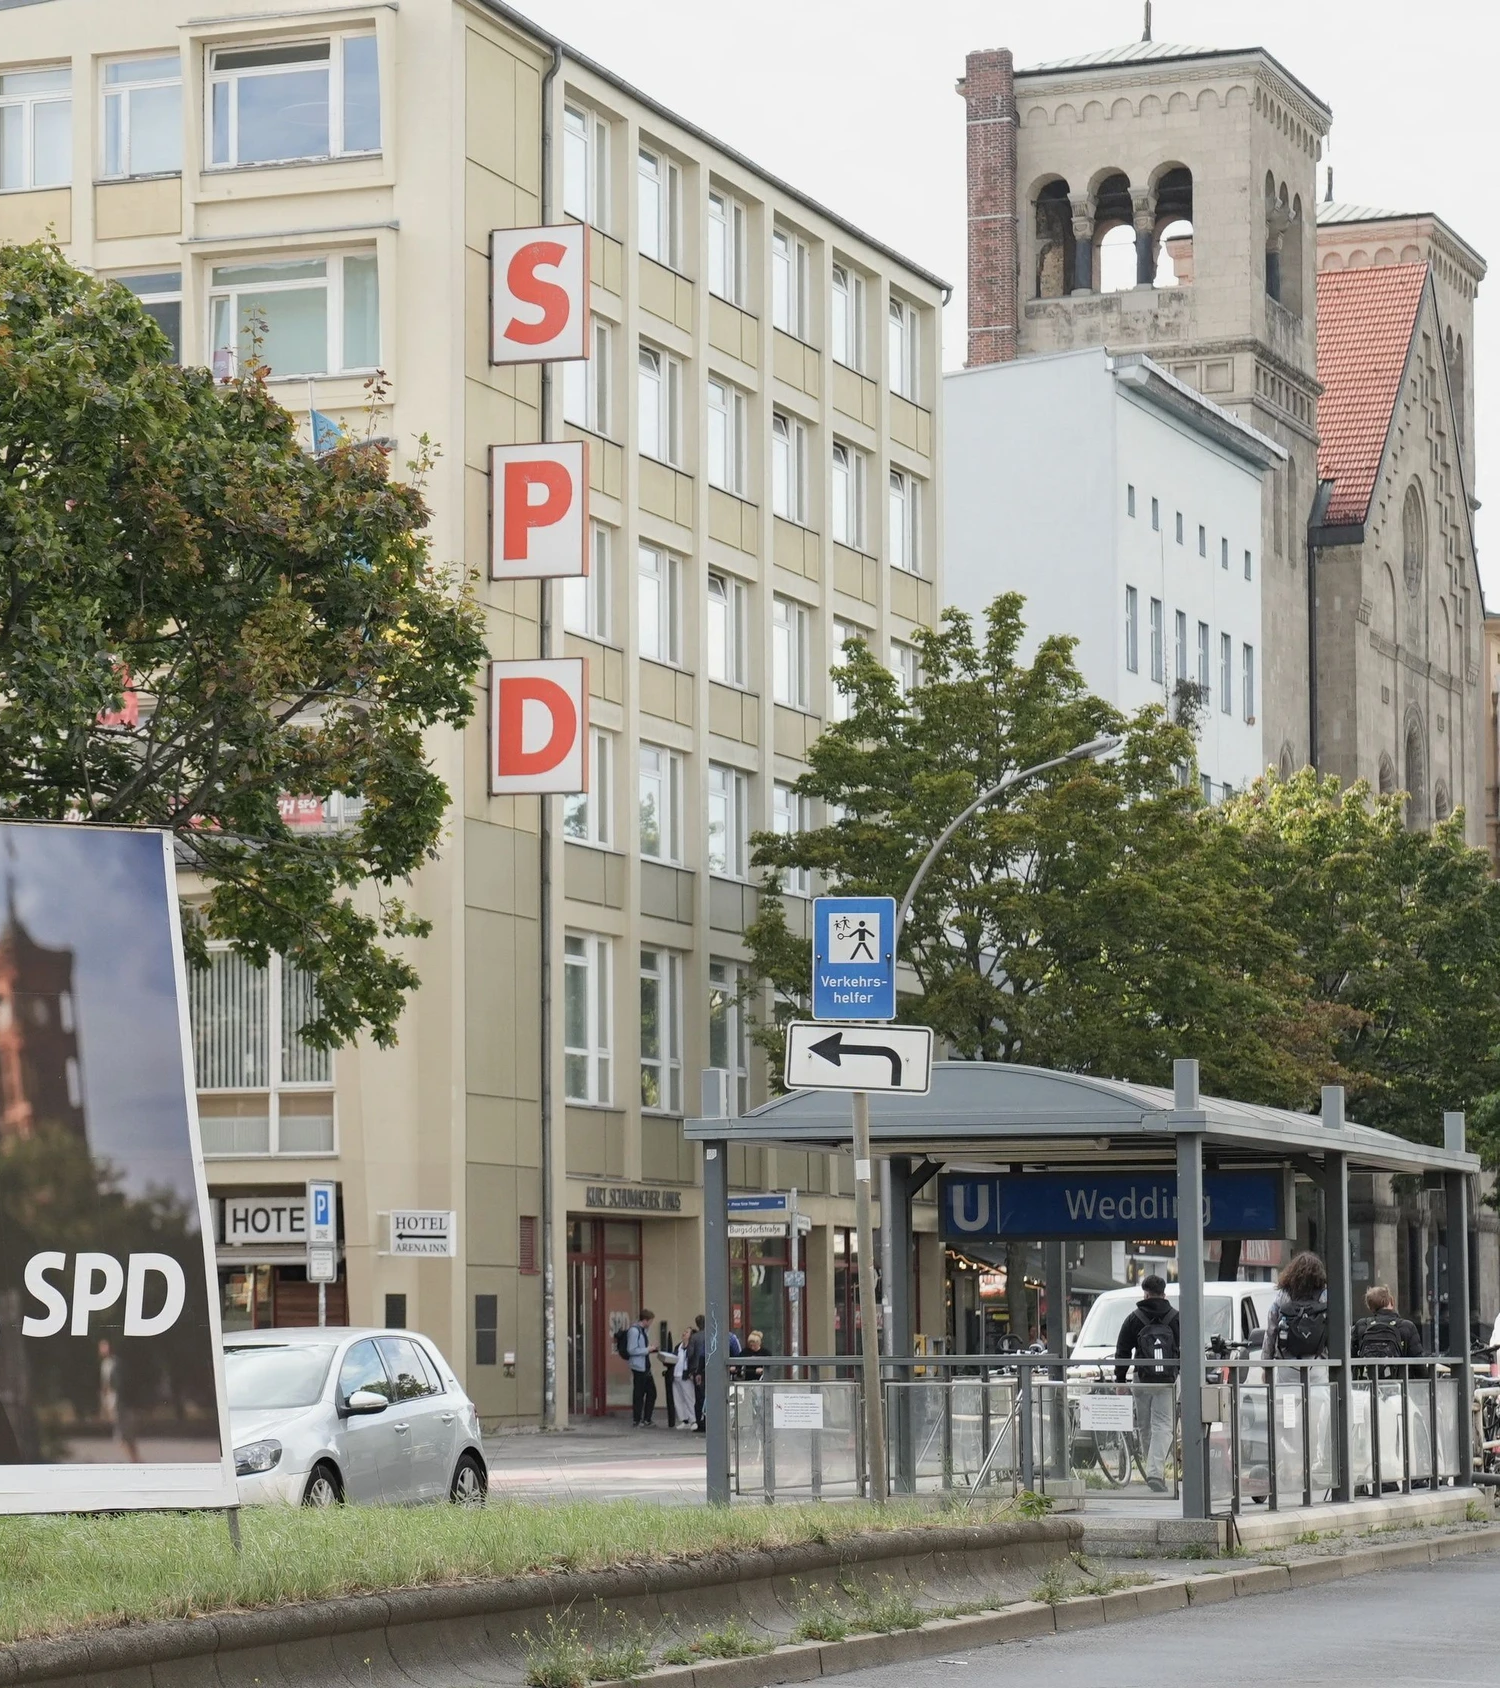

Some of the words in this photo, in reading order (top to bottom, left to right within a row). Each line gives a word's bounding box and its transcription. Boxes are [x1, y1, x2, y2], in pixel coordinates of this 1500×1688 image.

[820, 975, 888, 988] Verkehrs-
[833, 991, 874, 1004] helfer
[952, 1183, 990, 1232] U
[1065, 1188, 1212, 1226] Weddig
[232, 1206, 305, 1234] HOTE
[395, 1216, 448, 1230] HOTEL
[729, 1225, 781, 1234] Burgsdorfstraße
[395, 1243, 427, 1252] ARENA
[429, 1243, 447, 1252] INN
[21, 1250, 187, 1338] SPD
